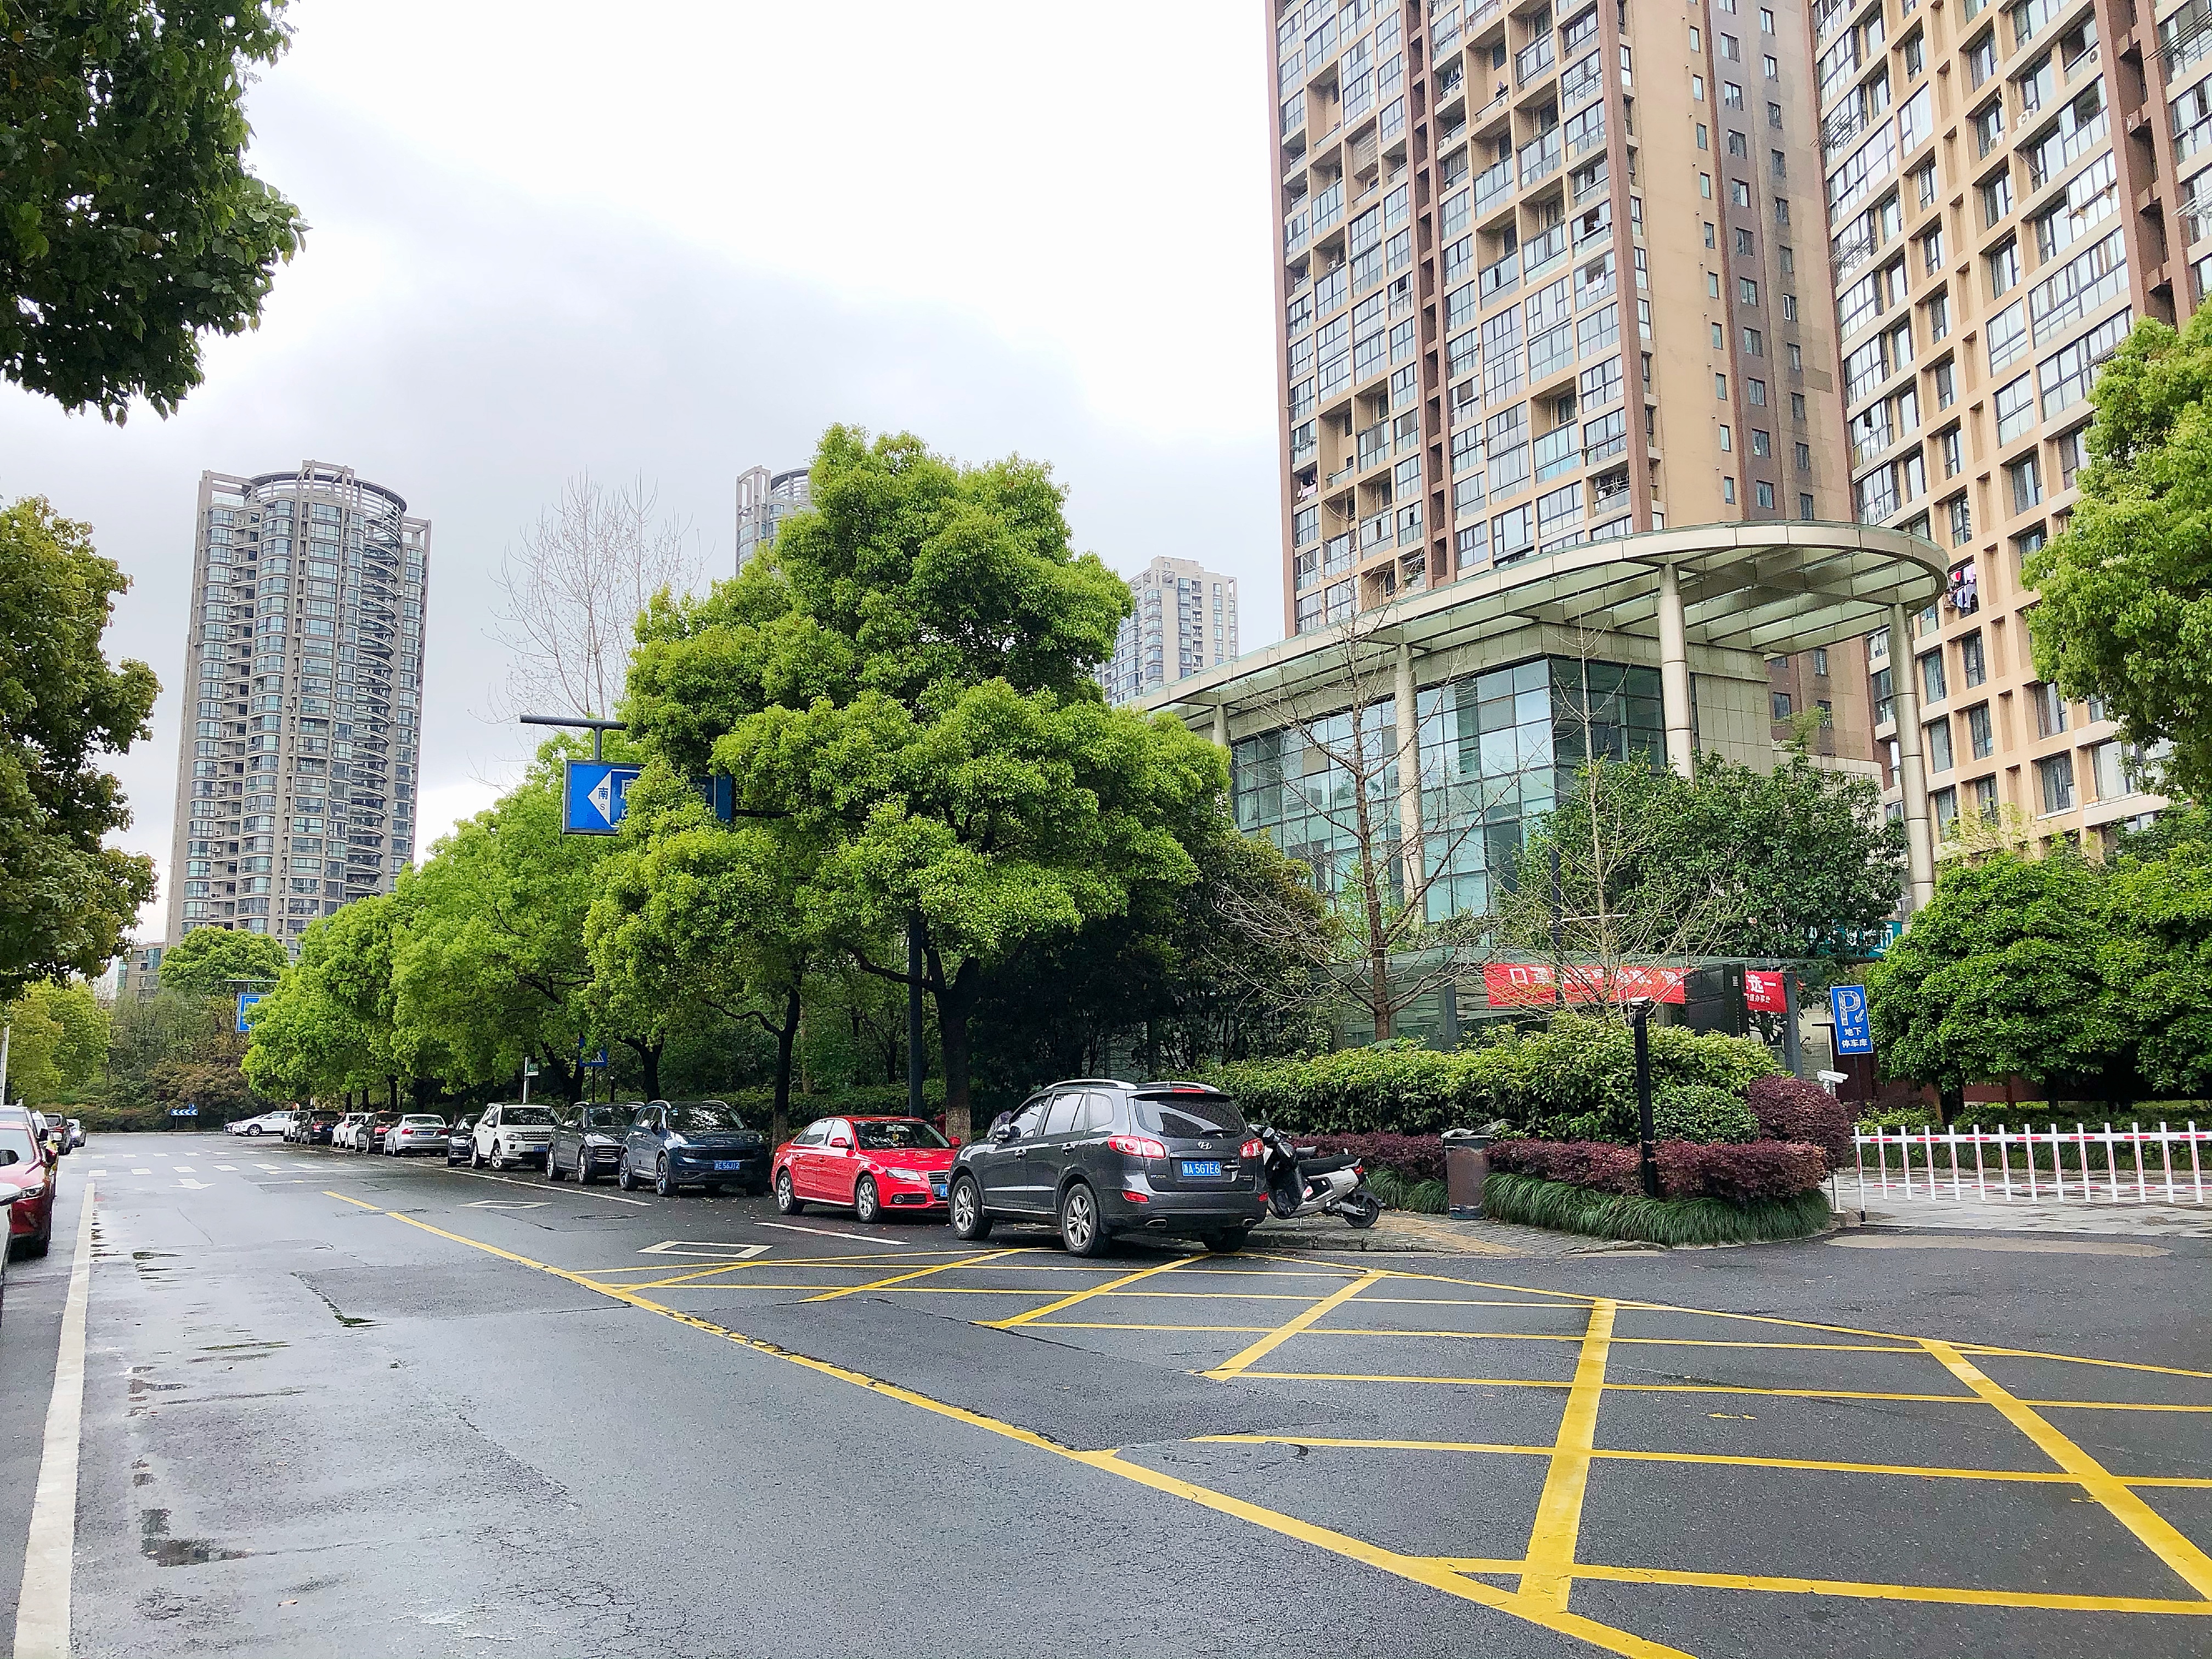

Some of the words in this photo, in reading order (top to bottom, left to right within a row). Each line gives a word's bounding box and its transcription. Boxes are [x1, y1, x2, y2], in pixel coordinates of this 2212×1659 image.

[598, 787, 608, 800] 南
[1746, 974, 1776, 994] 选一
[1838, 991, 1861, 1026] P
[1844, 1027, 1862, 1036] 地下
[1842, 1039, 1868, 1048] 停车库
